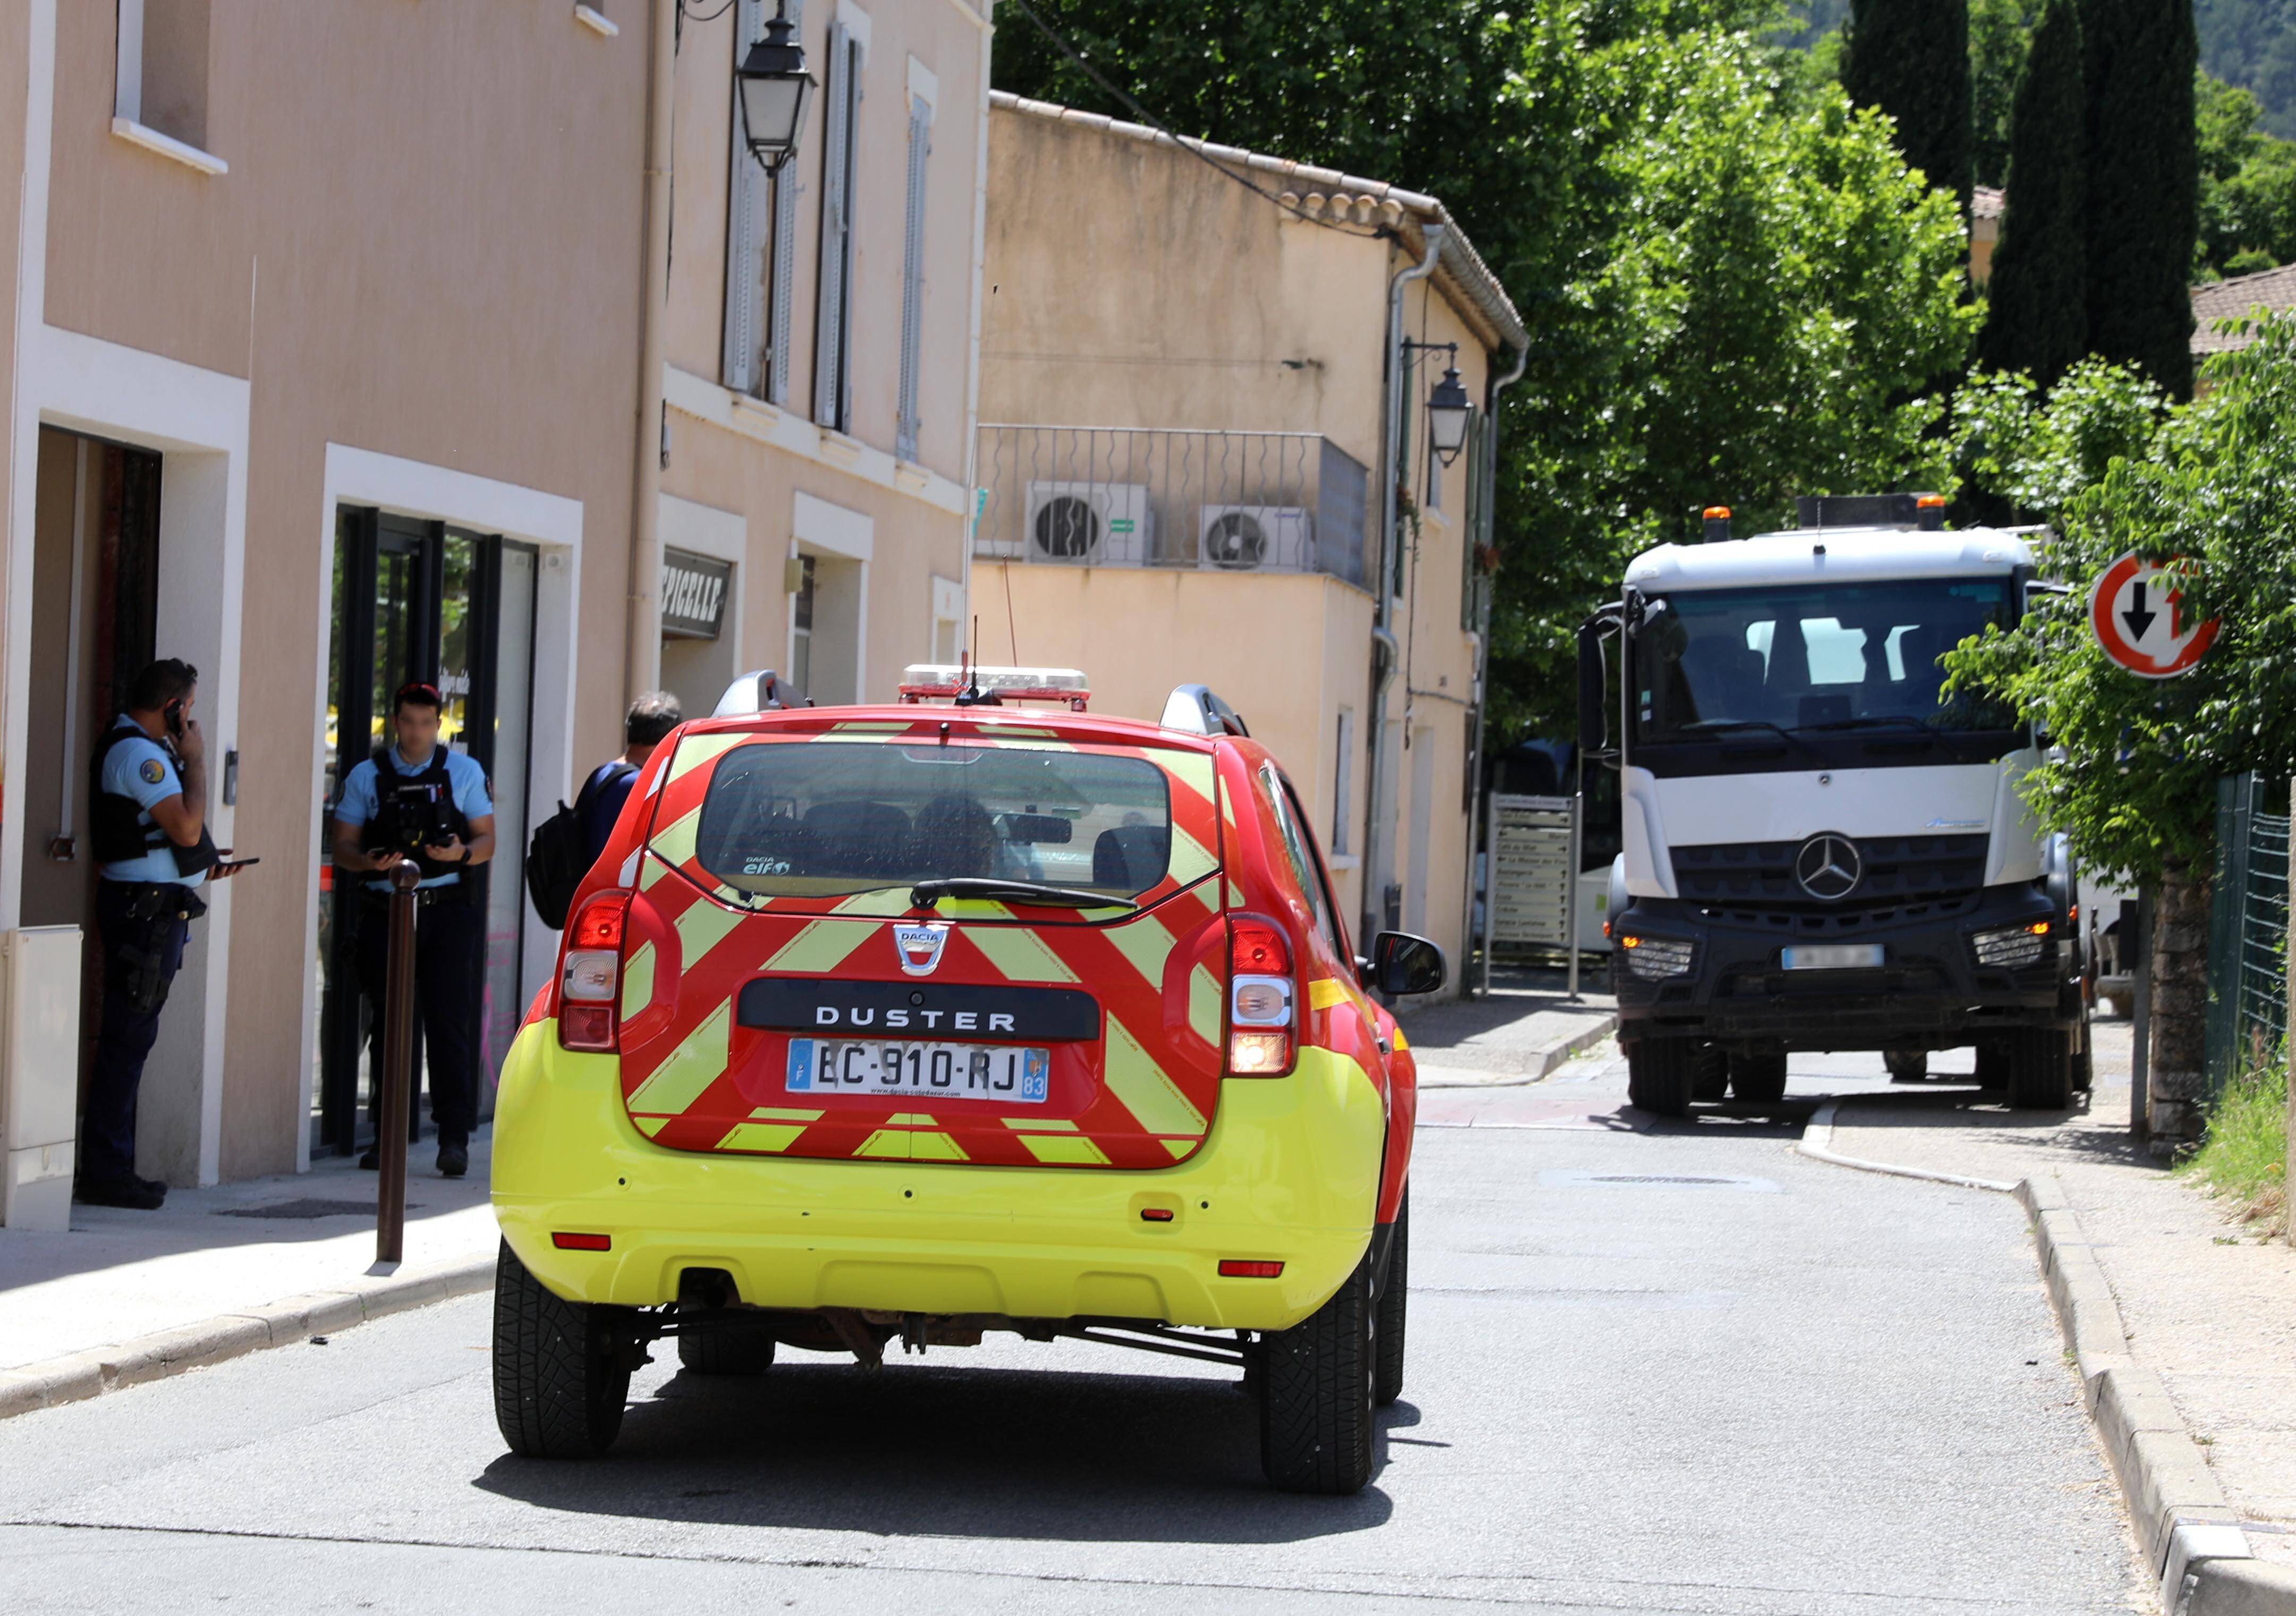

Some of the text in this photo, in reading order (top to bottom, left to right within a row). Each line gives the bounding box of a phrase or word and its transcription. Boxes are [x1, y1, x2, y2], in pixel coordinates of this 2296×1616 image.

[743, 862, 774, 875] elf
[816, 1006, 1015, 1031] DUSTER
[819, 1046, 1015, 1090] EC-910-RJ
[1023, 1076, 1045, 1095] 83
